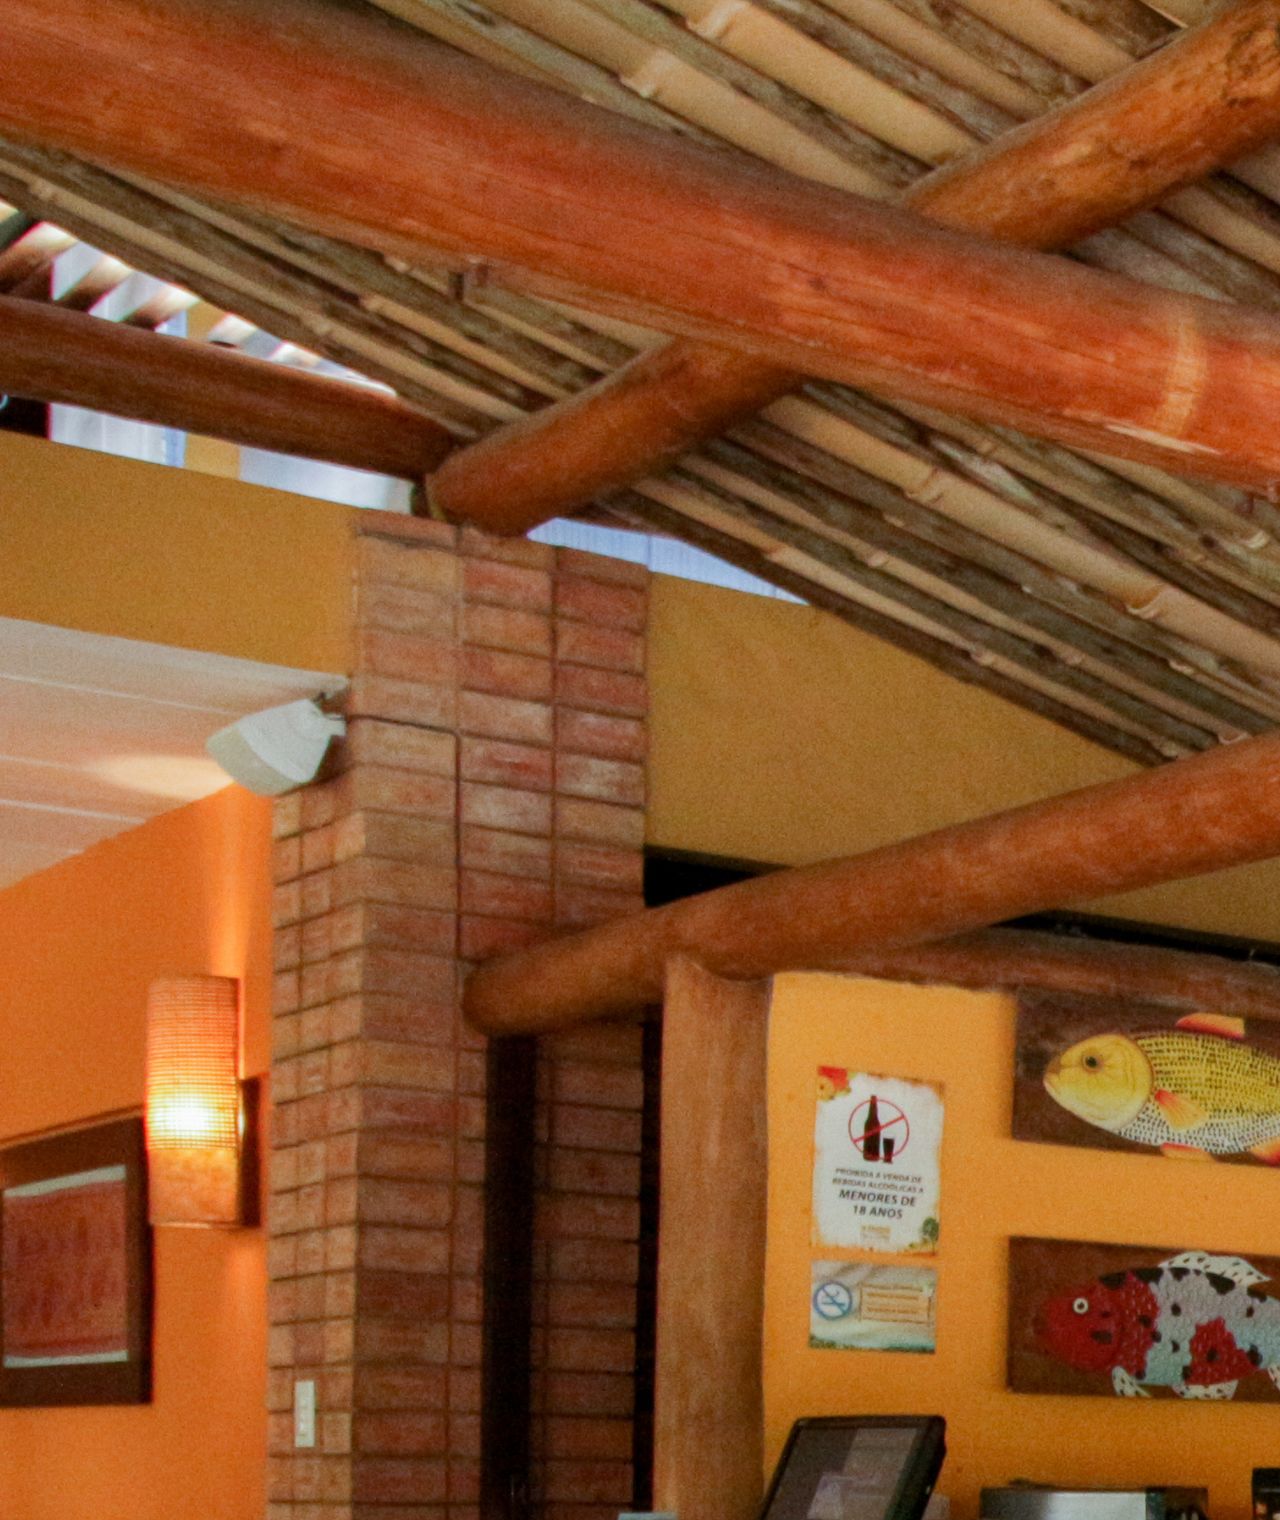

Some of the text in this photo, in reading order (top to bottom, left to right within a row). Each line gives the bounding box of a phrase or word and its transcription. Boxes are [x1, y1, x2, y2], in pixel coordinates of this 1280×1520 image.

[883, 1173, 910, 1182] VENDA
[911, 1175, 923, 1184] DE
[839, 1189, 917, 1207] MENORES DE
[853, 1204, 903, 1220] 18 ANOS
